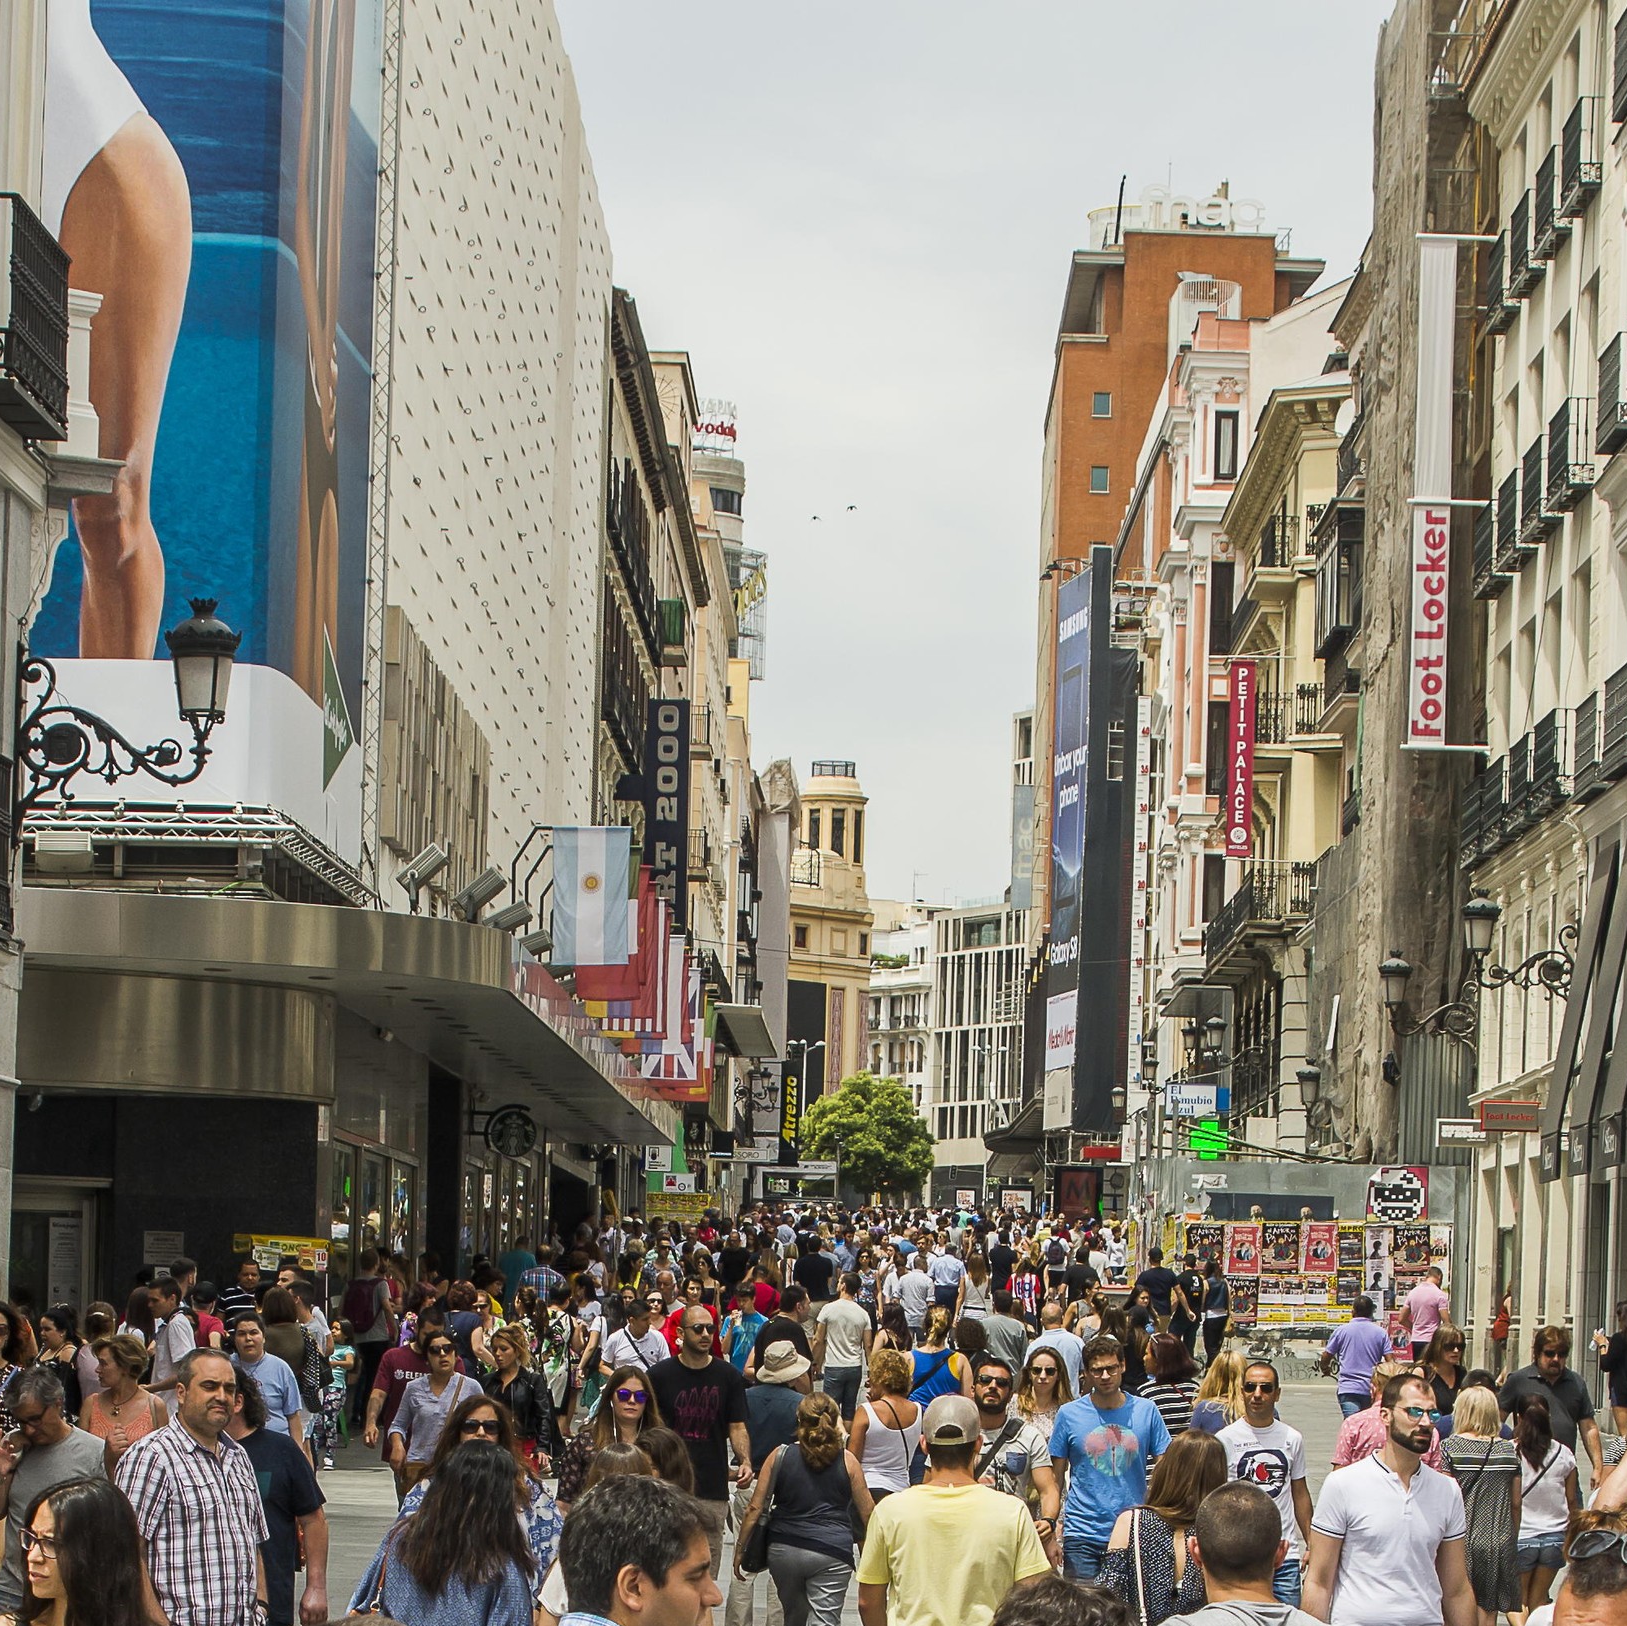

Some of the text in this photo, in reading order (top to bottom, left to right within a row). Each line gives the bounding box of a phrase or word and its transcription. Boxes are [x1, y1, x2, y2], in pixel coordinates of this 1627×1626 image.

[1059, 606, 1089, 644] SAMSUNG
[1054, 746, 1073, 780] Unbox
[1234, 667, 1250, 825] PETIT PALACE
[656, 704, 680, 823] 2000
[1059, 783, 1079, 817] phone
[1014, 817, 1033, 880] fnac
[1050, 938, 1071, 968] Galaxy
[1171, 1085, 1182, 1095] El
[317, 1252, 327, 1262] 10
[1192, 1275, 1200, 1287] 3
